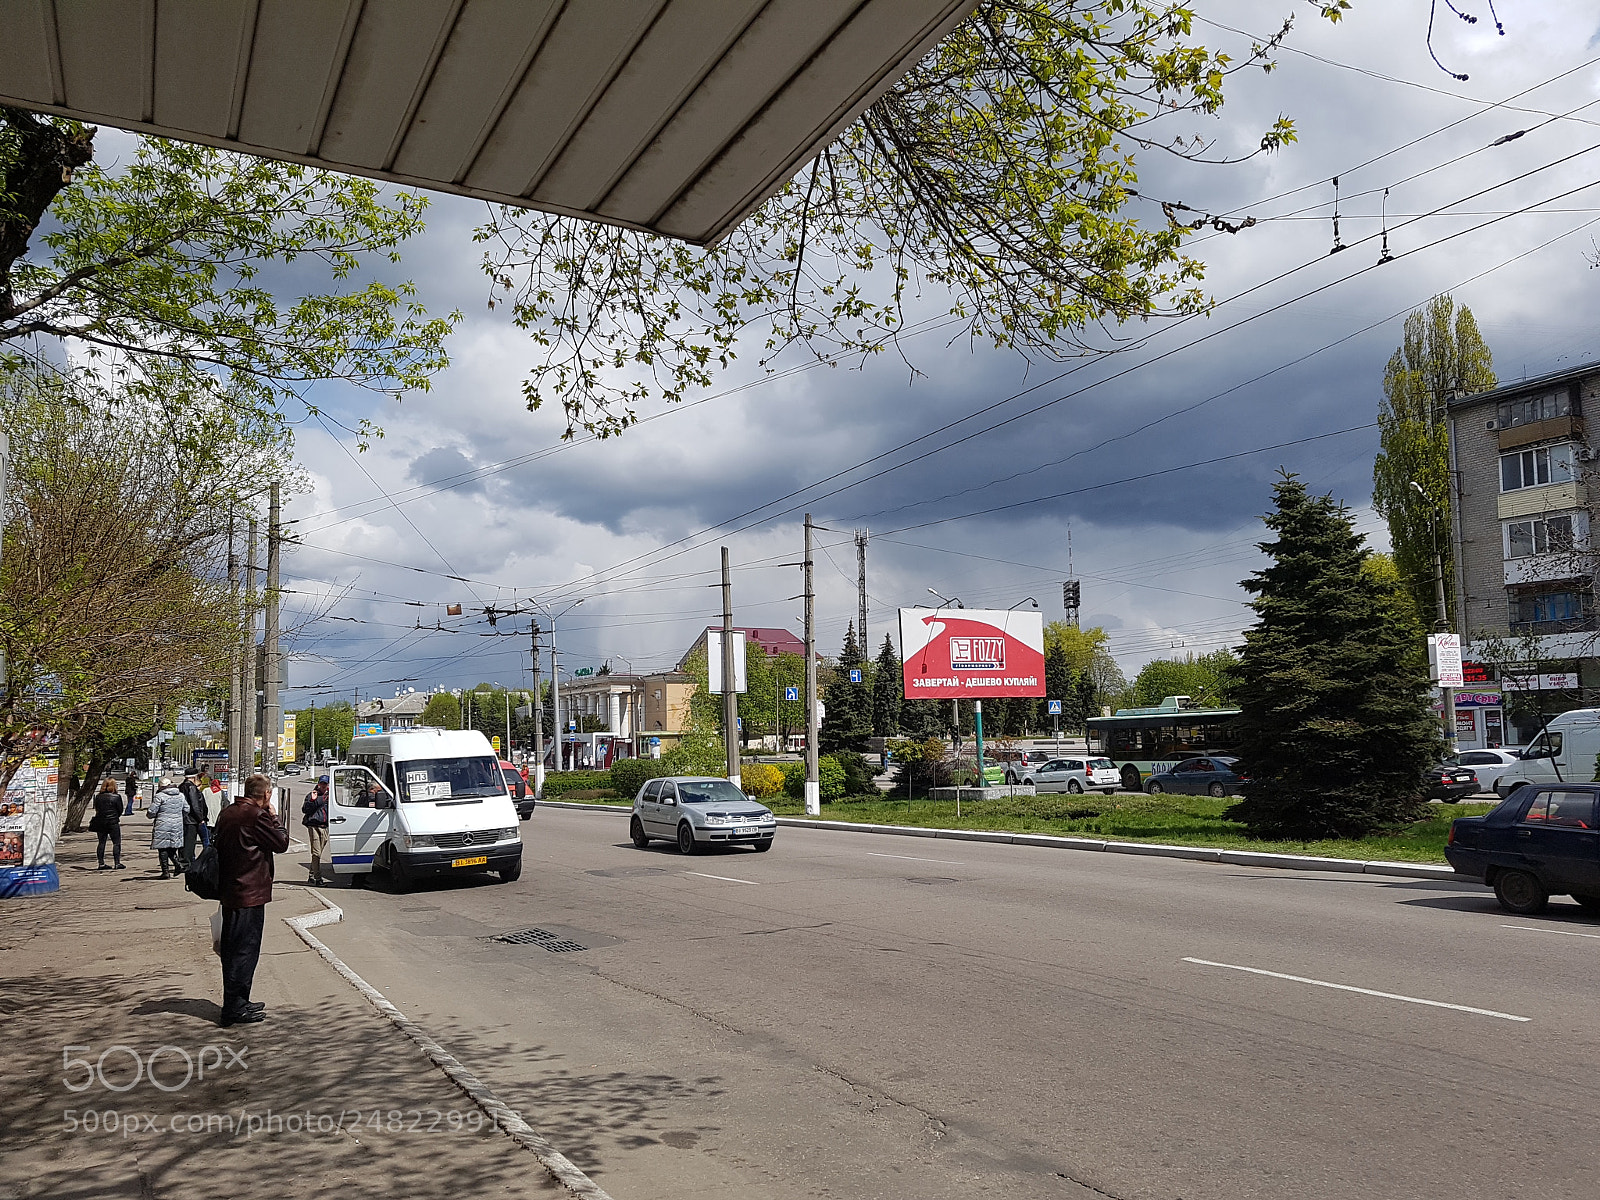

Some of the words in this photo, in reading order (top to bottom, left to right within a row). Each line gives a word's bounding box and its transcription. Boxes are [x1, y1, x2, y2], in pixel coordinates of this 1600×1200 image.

[973, 639, 1004, 662] FOZZY
[912, 675, 960, 688] ЗАВЕРТАЙ
[965, 677, 1002, 688] ДЕШЕВО
[1003, 675, 1038, 687] КУПЛЯЙ!
[408, 773, 427, 782] НПЗ
[425, 785, 437, 796] 17
